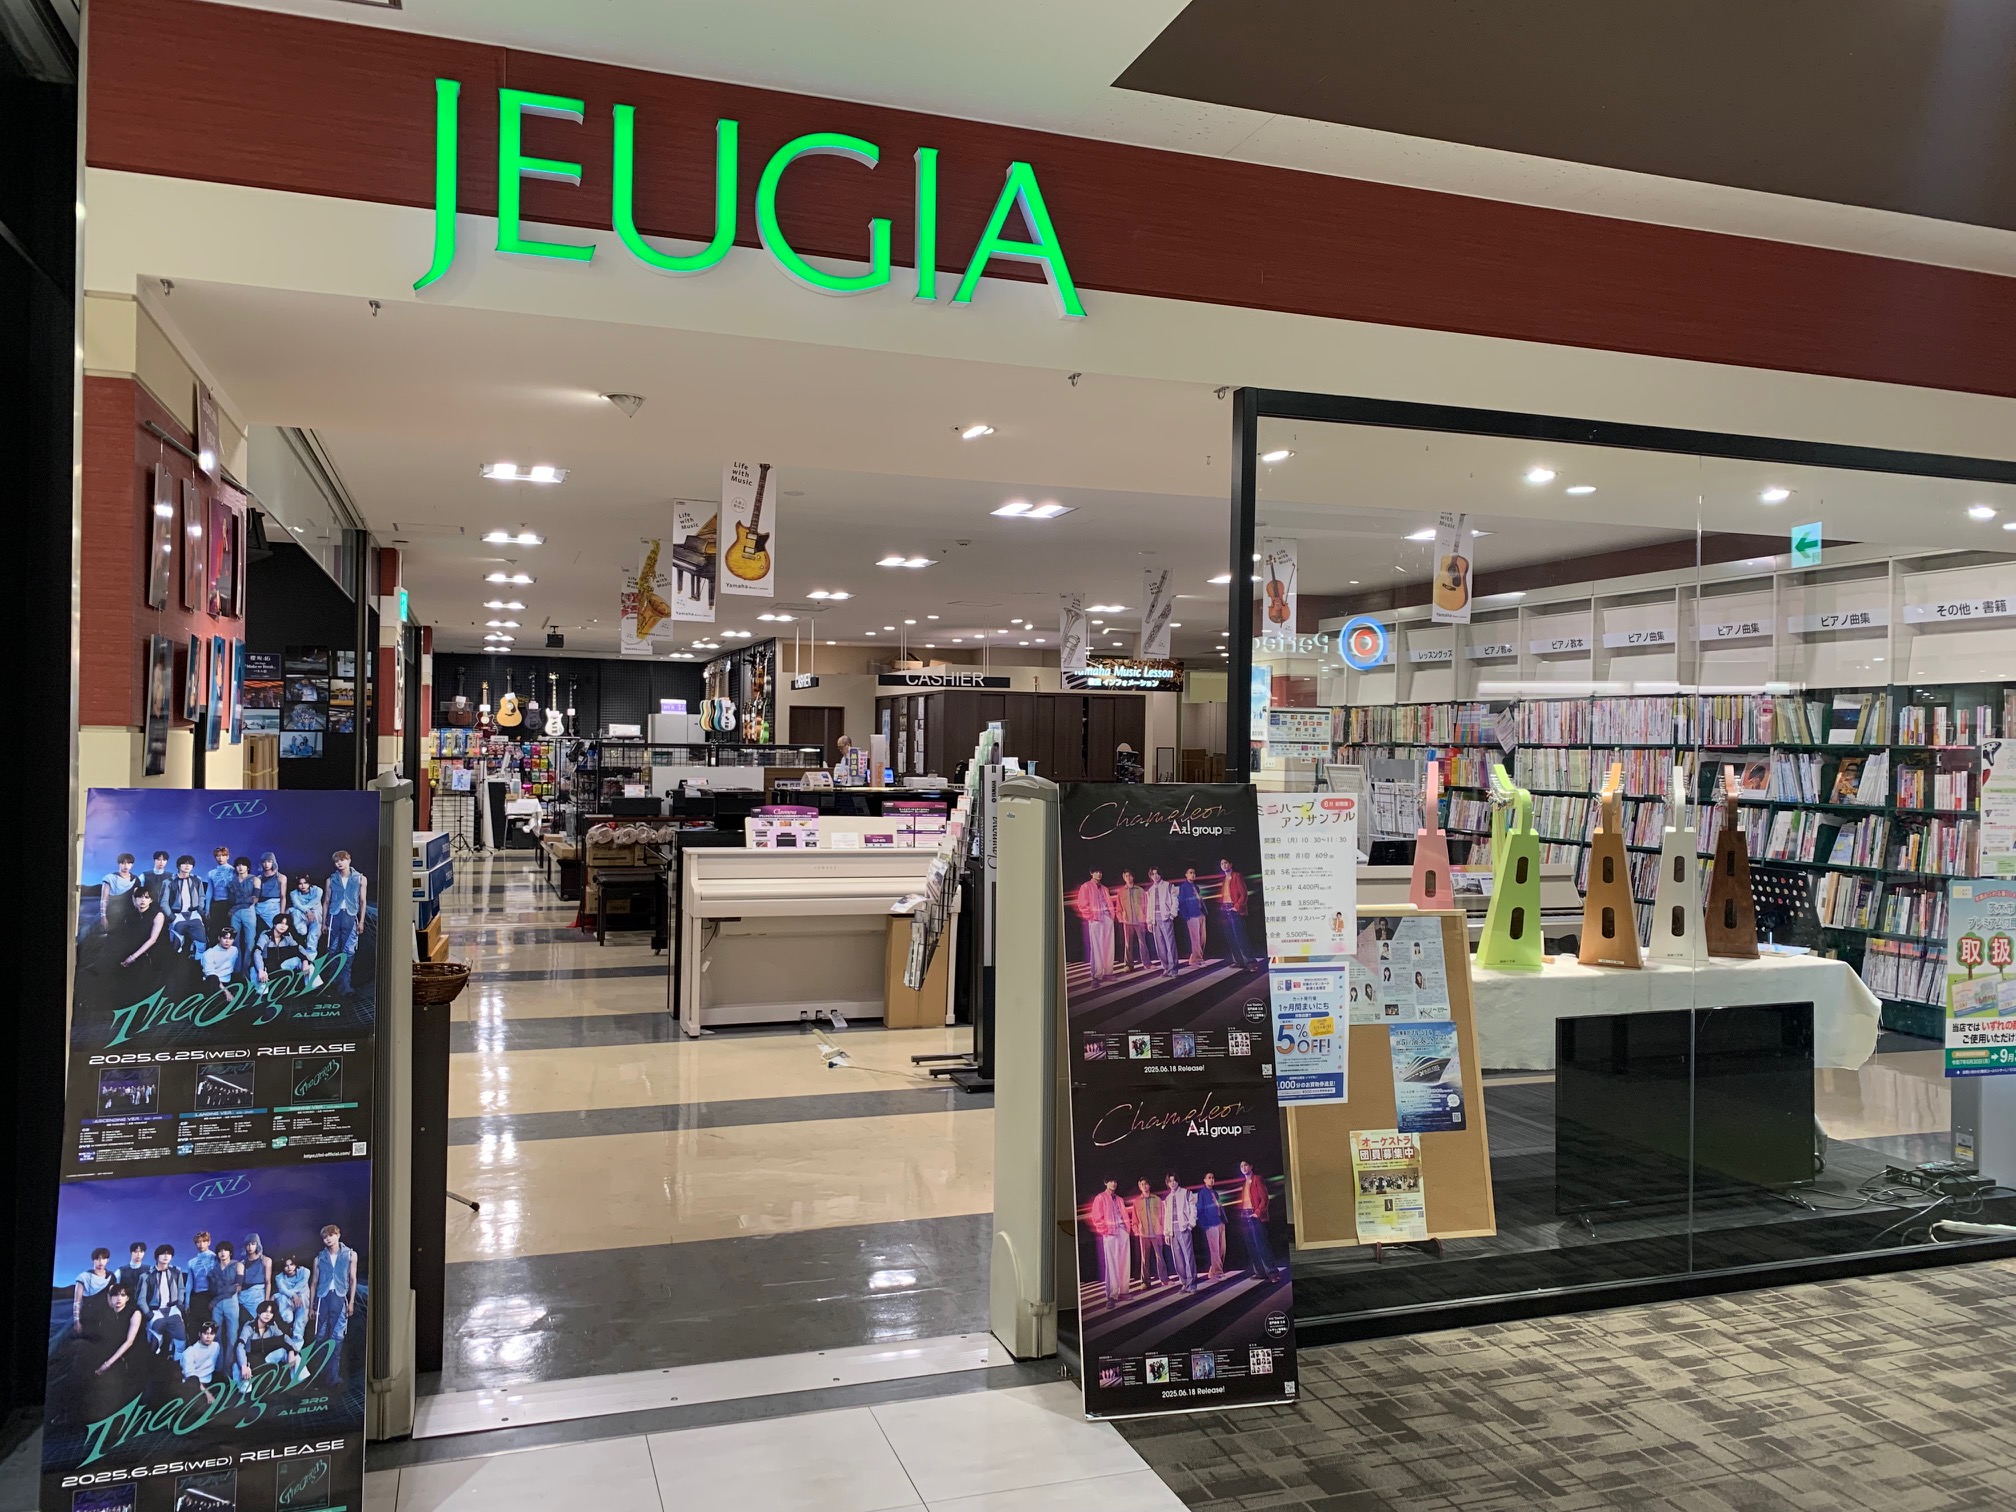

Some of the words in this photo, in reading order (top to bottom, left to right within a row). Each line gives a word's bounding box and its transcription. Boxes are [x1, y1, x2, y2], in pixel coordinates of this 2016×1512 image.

[413, 78, 1087, 318] JEUGIA
[734, 461, 749, 470] Life
[732, 469, 750, 478] with
[731, 476, 753, 486] Music
[1936, 600, 2007, 617] その他・書籍
[1820, 612, 1871, 627] ピアノ曲集
[1717, 622, 1760, 637] ピアノ曲集
[1628, 631, 1665, 643] ピアノ曲集
[1552, 639, 1584, 650] ピアノ教本
[1114, 665, 1142, 678] Music
[1144, 667, 1174, 679] Lesson
[905, 672, 985, 687] CASHIER
[1257, 798, 1317, 816] ミニハープ
[1078, 794, 1234, 840] Chameleon
[1281, 809, 1356, 828] アンサンブル
[1192, 824, 1223, 837] group
[293, 1010, 340, 1018] ALBUM
[314, 1003, 341, 1011] 3RD
[1278, 1002, 1330, 1012] 1ヶ月間まいにち
[1963, 1033, 2016, 1044] ご使用いただけ
[1297, 1039, 1331, 1054] OFF!
[88, 1049, 251, 1065] 2025.6.25(WED)
[257, 1043, 356, 1056] RELEASE
[2000, 1048, 2016, 1063] 9月
[1092, 1092, 1253, 1146] Chameleon
[1210, 1125, 1242, 1137] group
[1361, 1135, 1411, 1147] オーケストラ
[1359, 1147, 1415, 1161] 団員募集中
[1162, 1388, 1195, 1398] 2025.06.18
[1197, 1386, 1225, 1395] Release!
[277, 1404, 329, 1417] ALBUM
[61, 1454, 233, 1488] 2025.6.25(WED)
[239, 1439, 345, 1463] RELEASE
